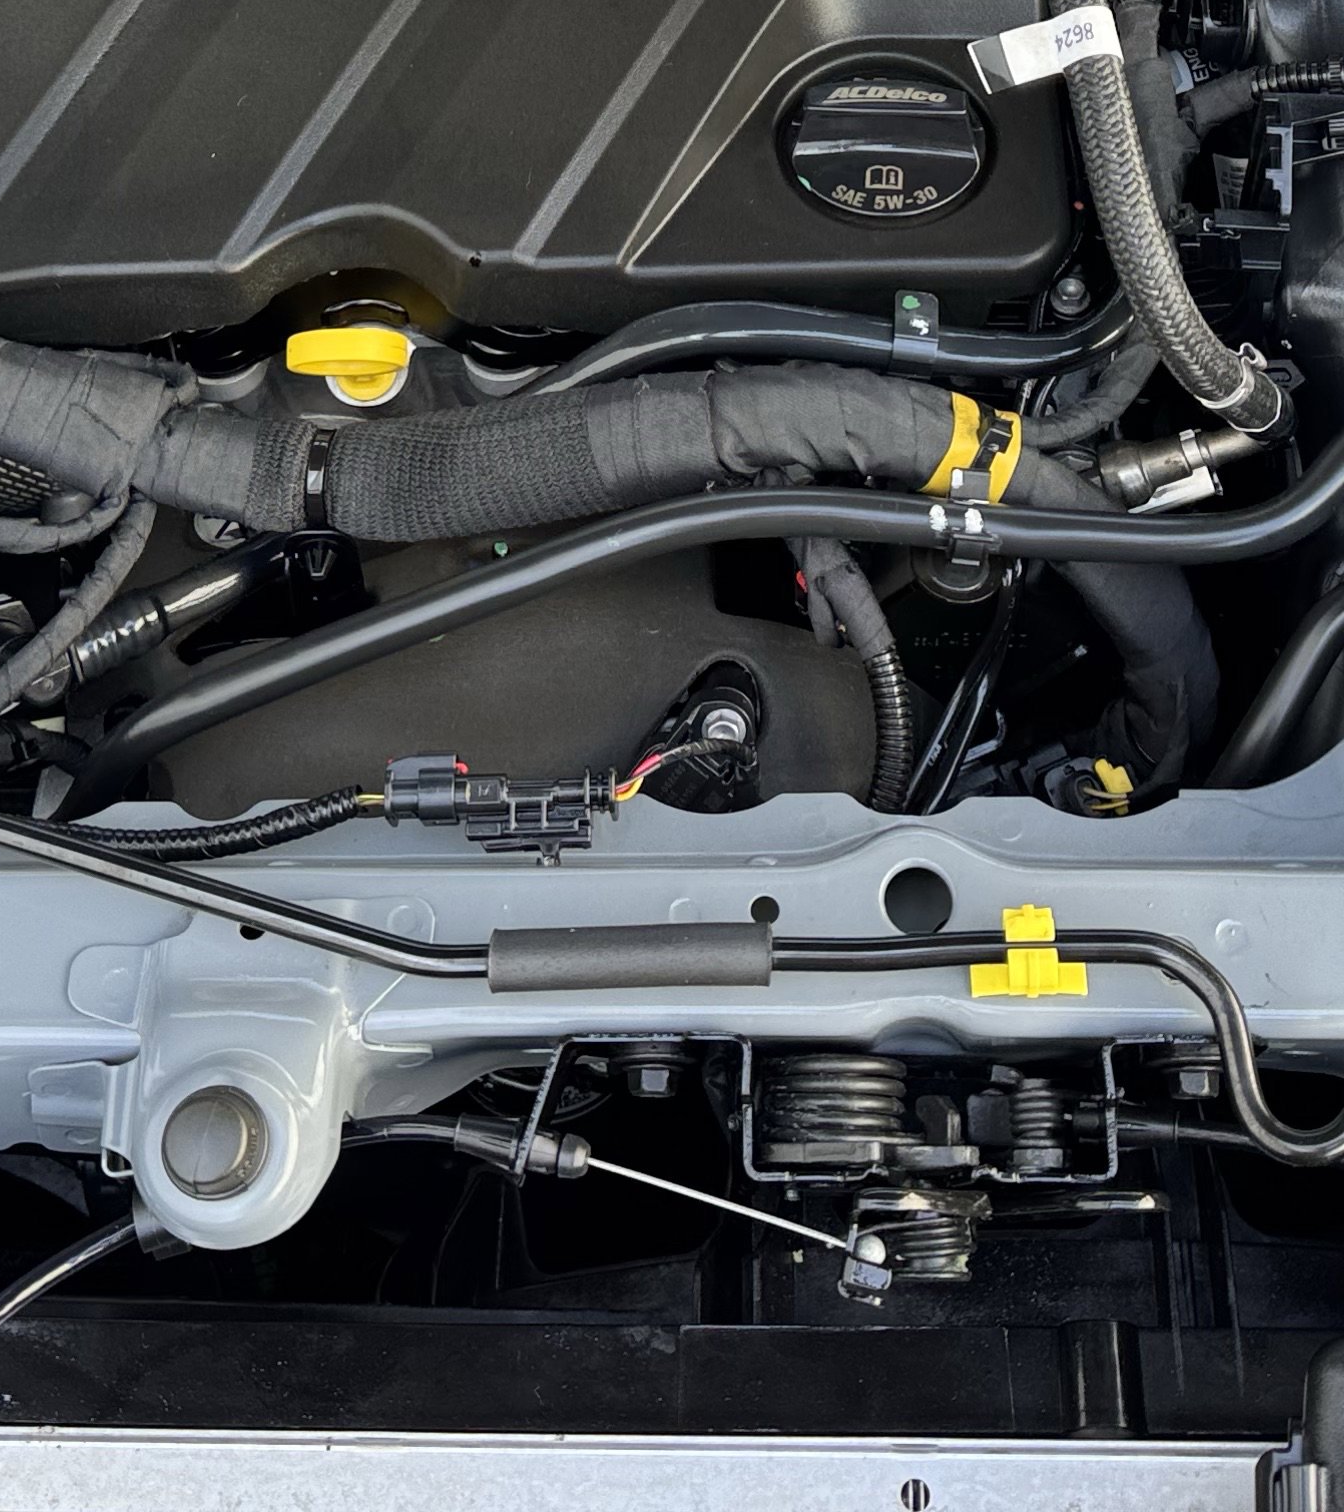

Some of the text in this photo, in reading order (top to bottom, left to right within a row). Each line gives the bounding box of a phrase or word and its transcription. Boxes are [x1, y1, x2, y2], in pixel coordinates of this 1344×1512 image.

[1056, 22, 1095, 53] 8624
[1182, 47, 1210, 82] ENG
[827, 86, 948, 103] ACDelco
[831, 185, 939, 210] SAE 5W-30
